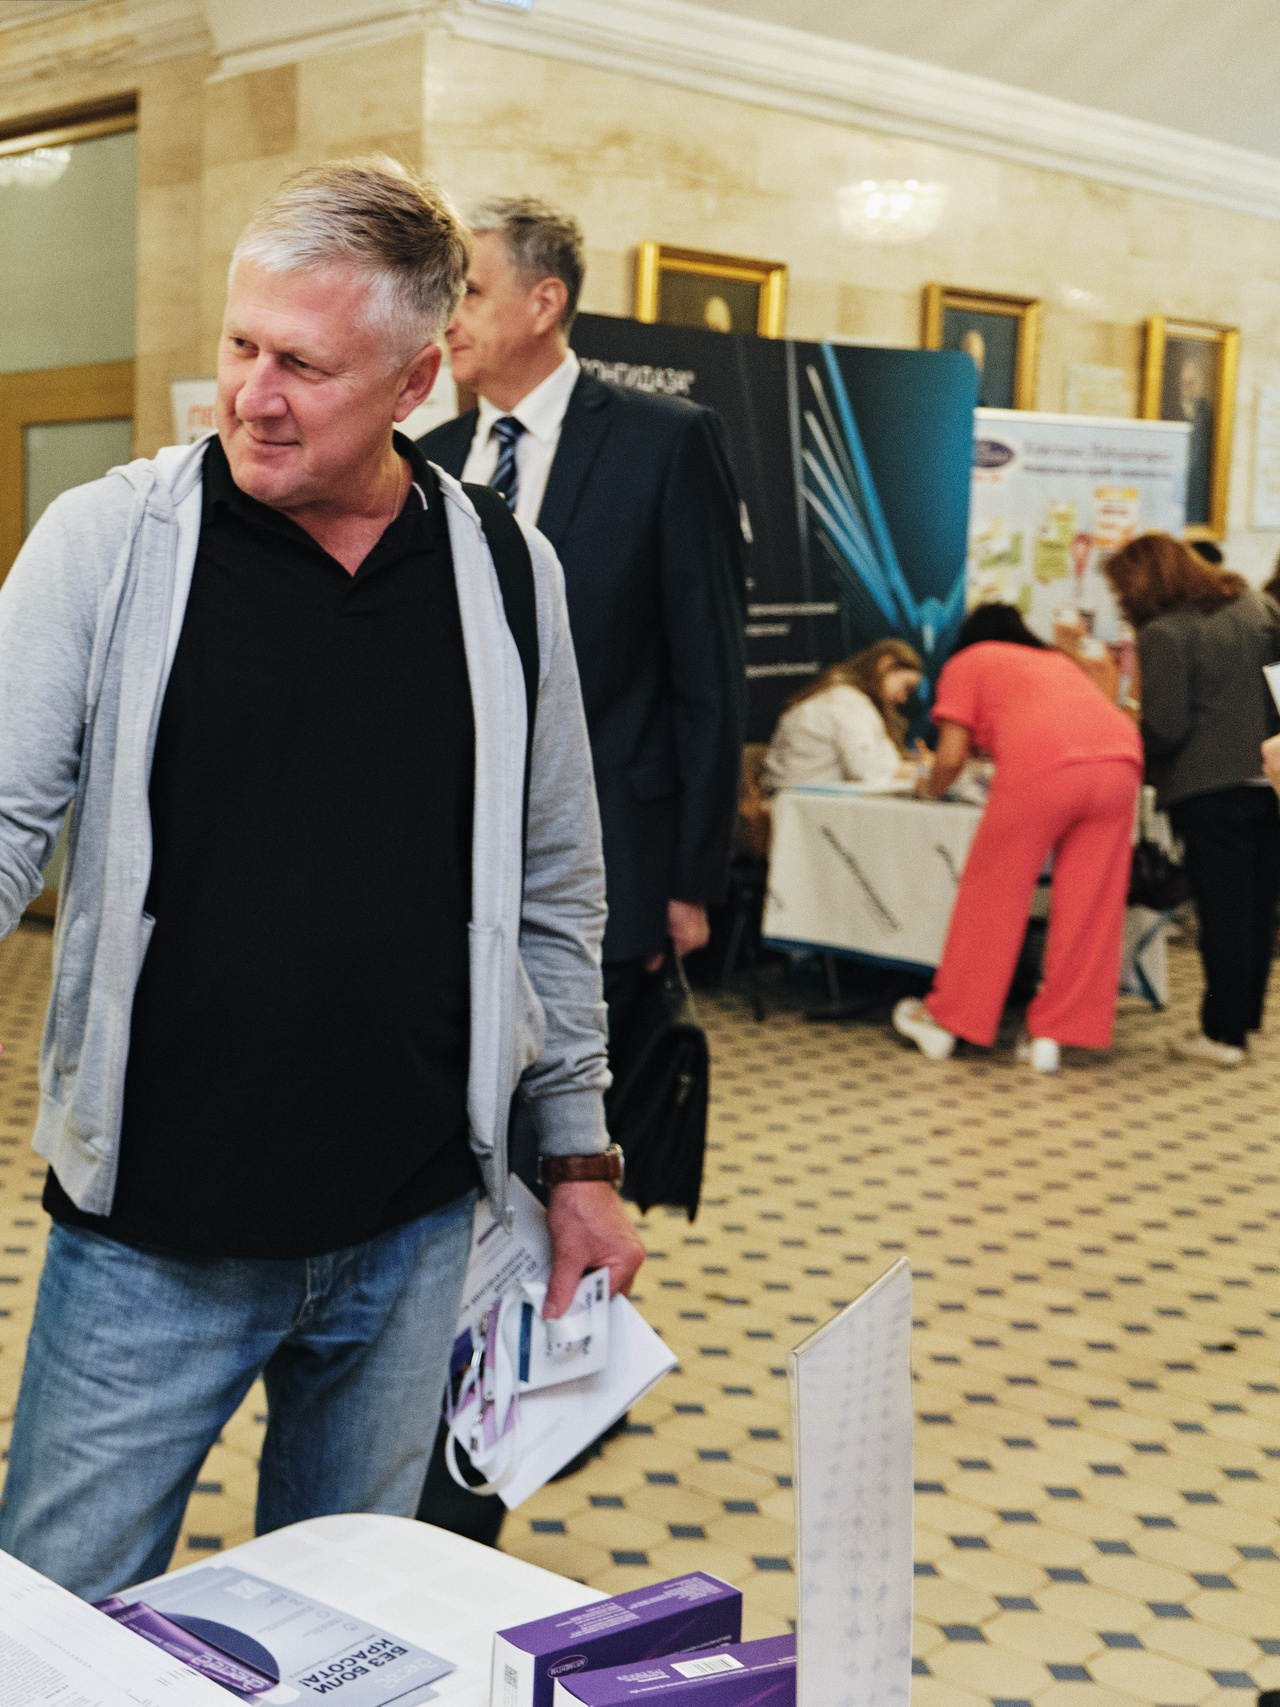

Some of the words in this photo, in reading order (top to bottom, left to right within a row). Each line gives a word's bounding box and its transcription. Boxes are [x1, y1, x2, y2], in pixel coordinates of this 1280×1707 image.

[297, 1637, 396, 1688] КРАСОТА!
[366, 1645, 409, 1669] БЕЗ
[312, 1665, 370, 1695] БОЛИ
